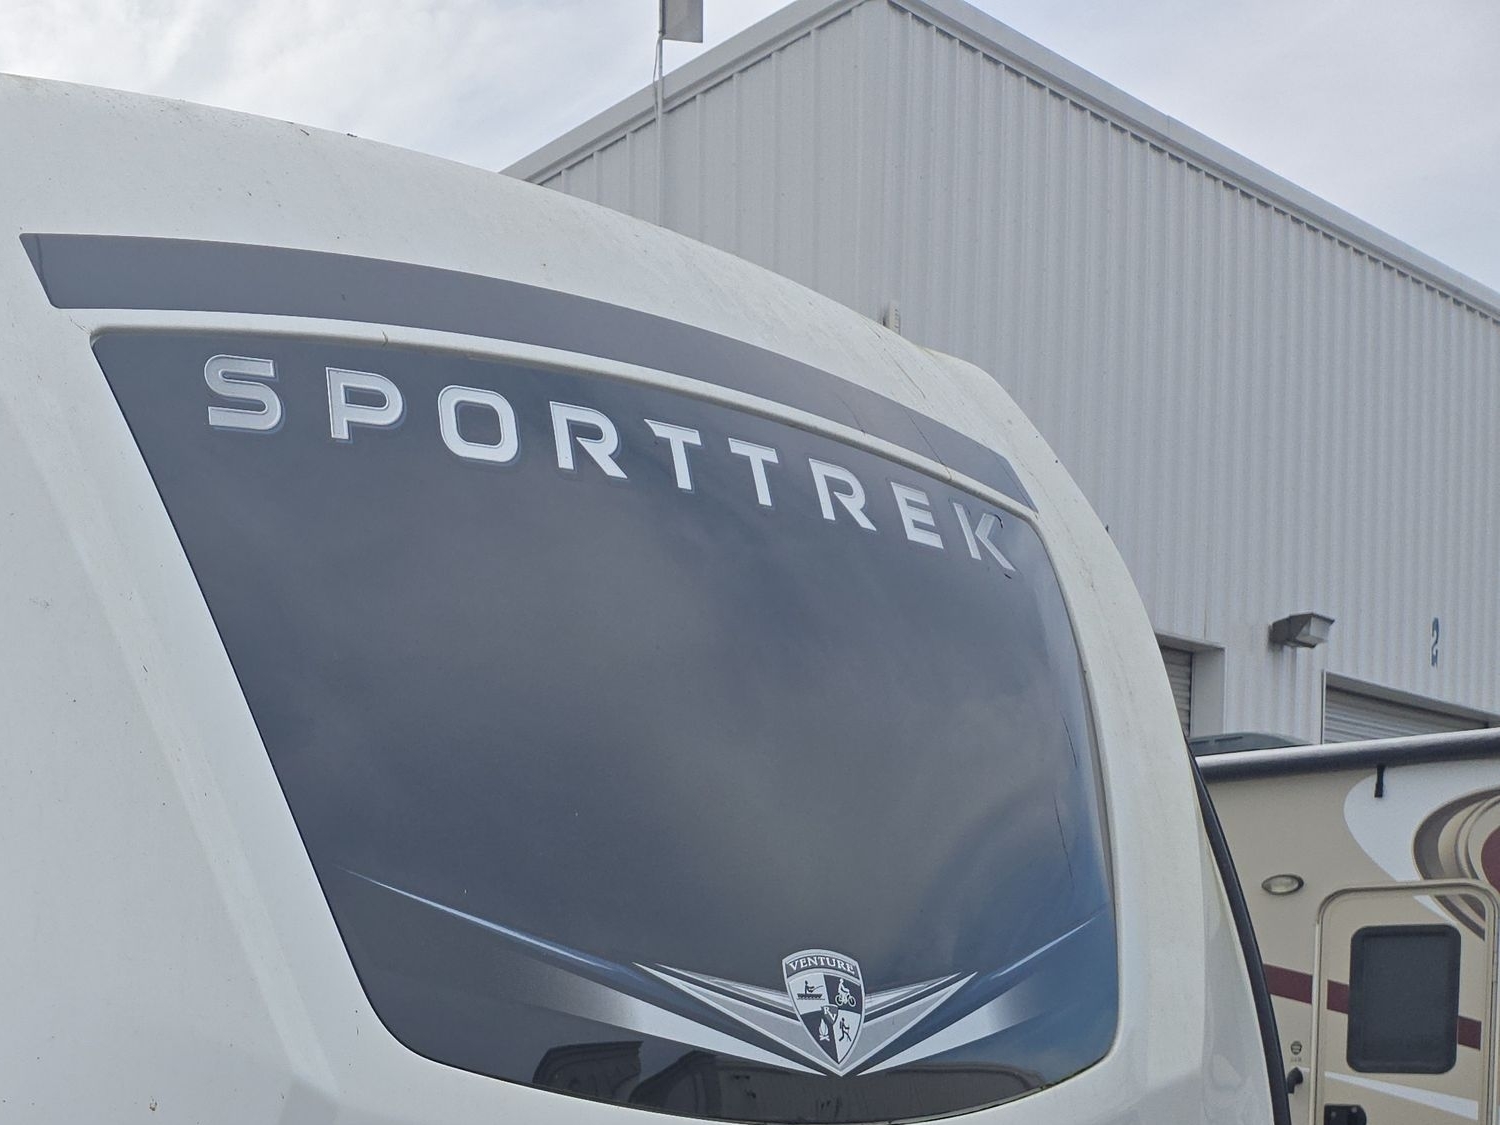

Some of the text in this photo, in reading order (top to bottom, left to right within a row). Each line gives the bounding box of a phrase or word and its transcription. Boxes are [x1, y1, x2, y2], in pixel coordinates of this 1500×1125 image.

[203, 353, 1018, 574] SPORTTREK
[1431, 617, 1439, 668] 2
[789, 956, 855, 975] VENTURE
[823, 1006, 837, 1021] RV
